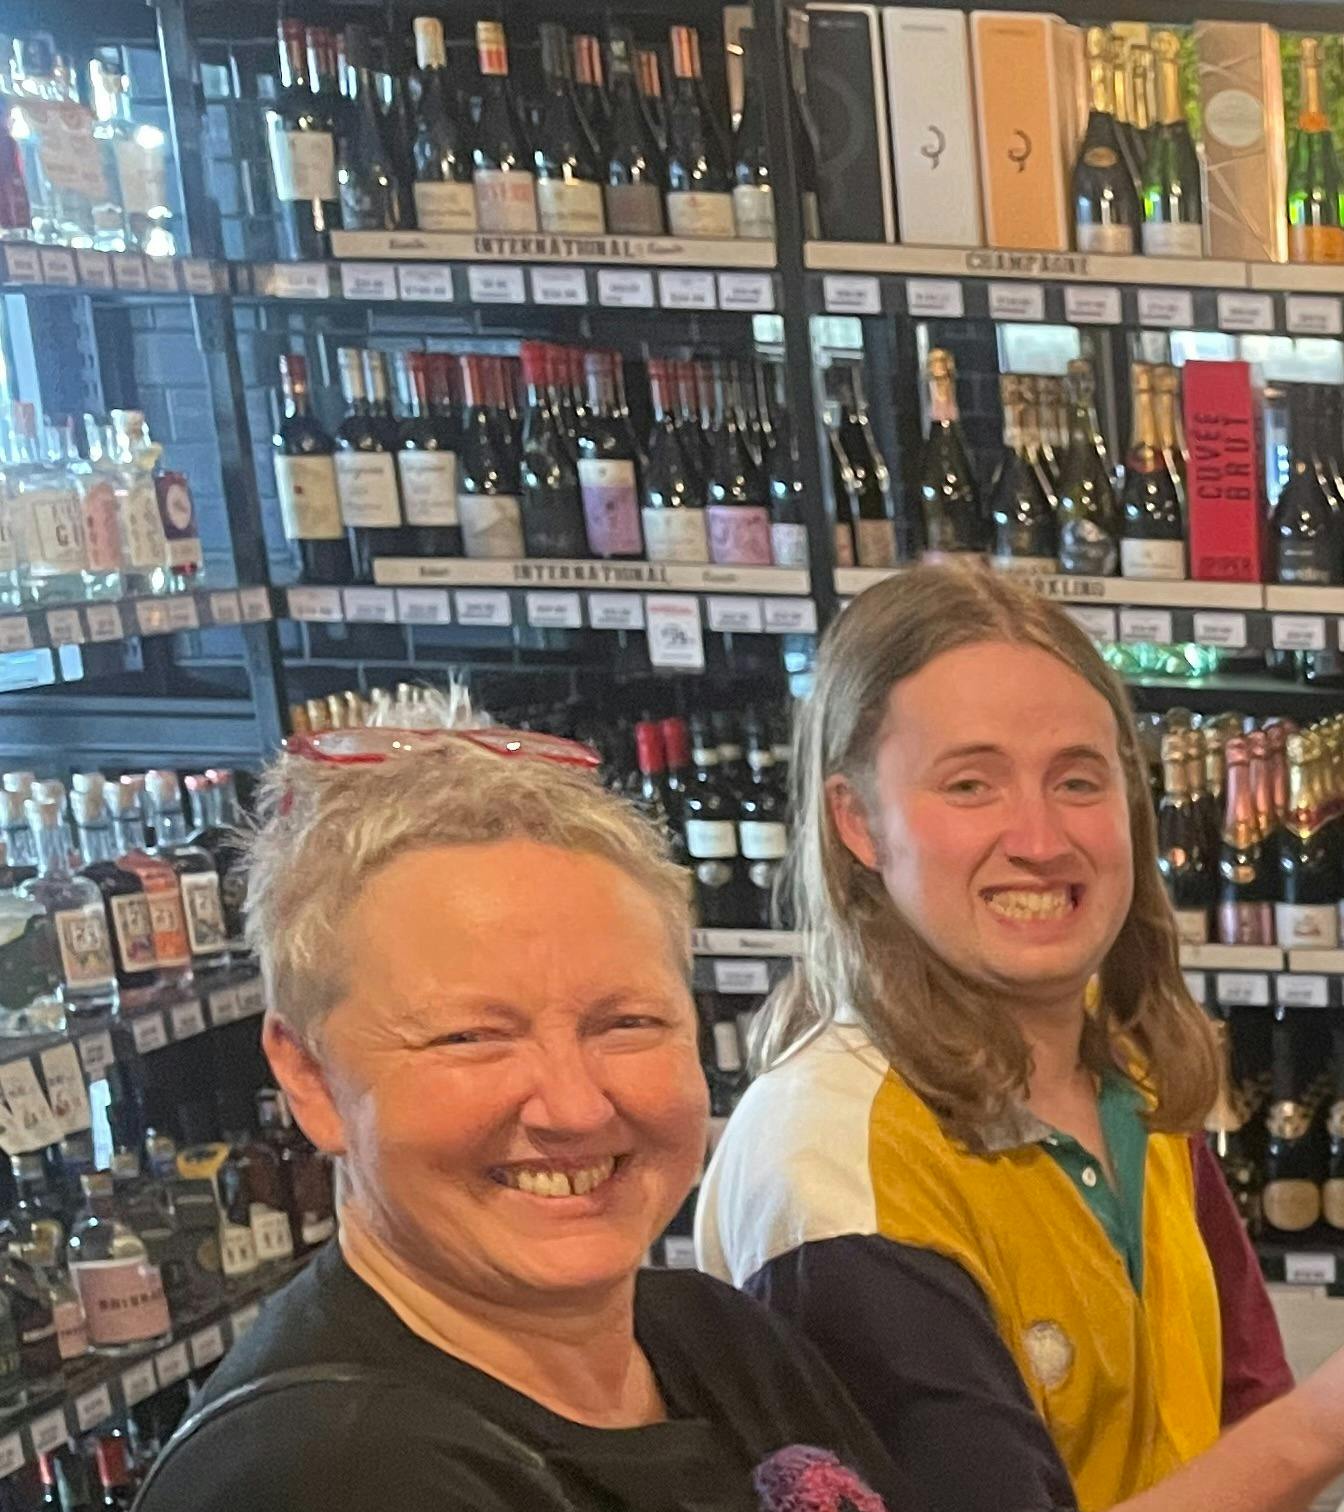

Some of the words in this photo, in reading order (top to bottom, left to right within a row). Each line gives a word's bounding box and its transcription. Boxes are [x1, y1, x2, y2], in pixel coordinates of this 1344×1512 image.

[474, 236, 636, 257] INTERNATIONAL
[965, 251, 1089, 276] CHAMPAGNE
[1223, 416, 1251, 500] BRUT
[512, 564, 670, 585] INTERNATIONAL
